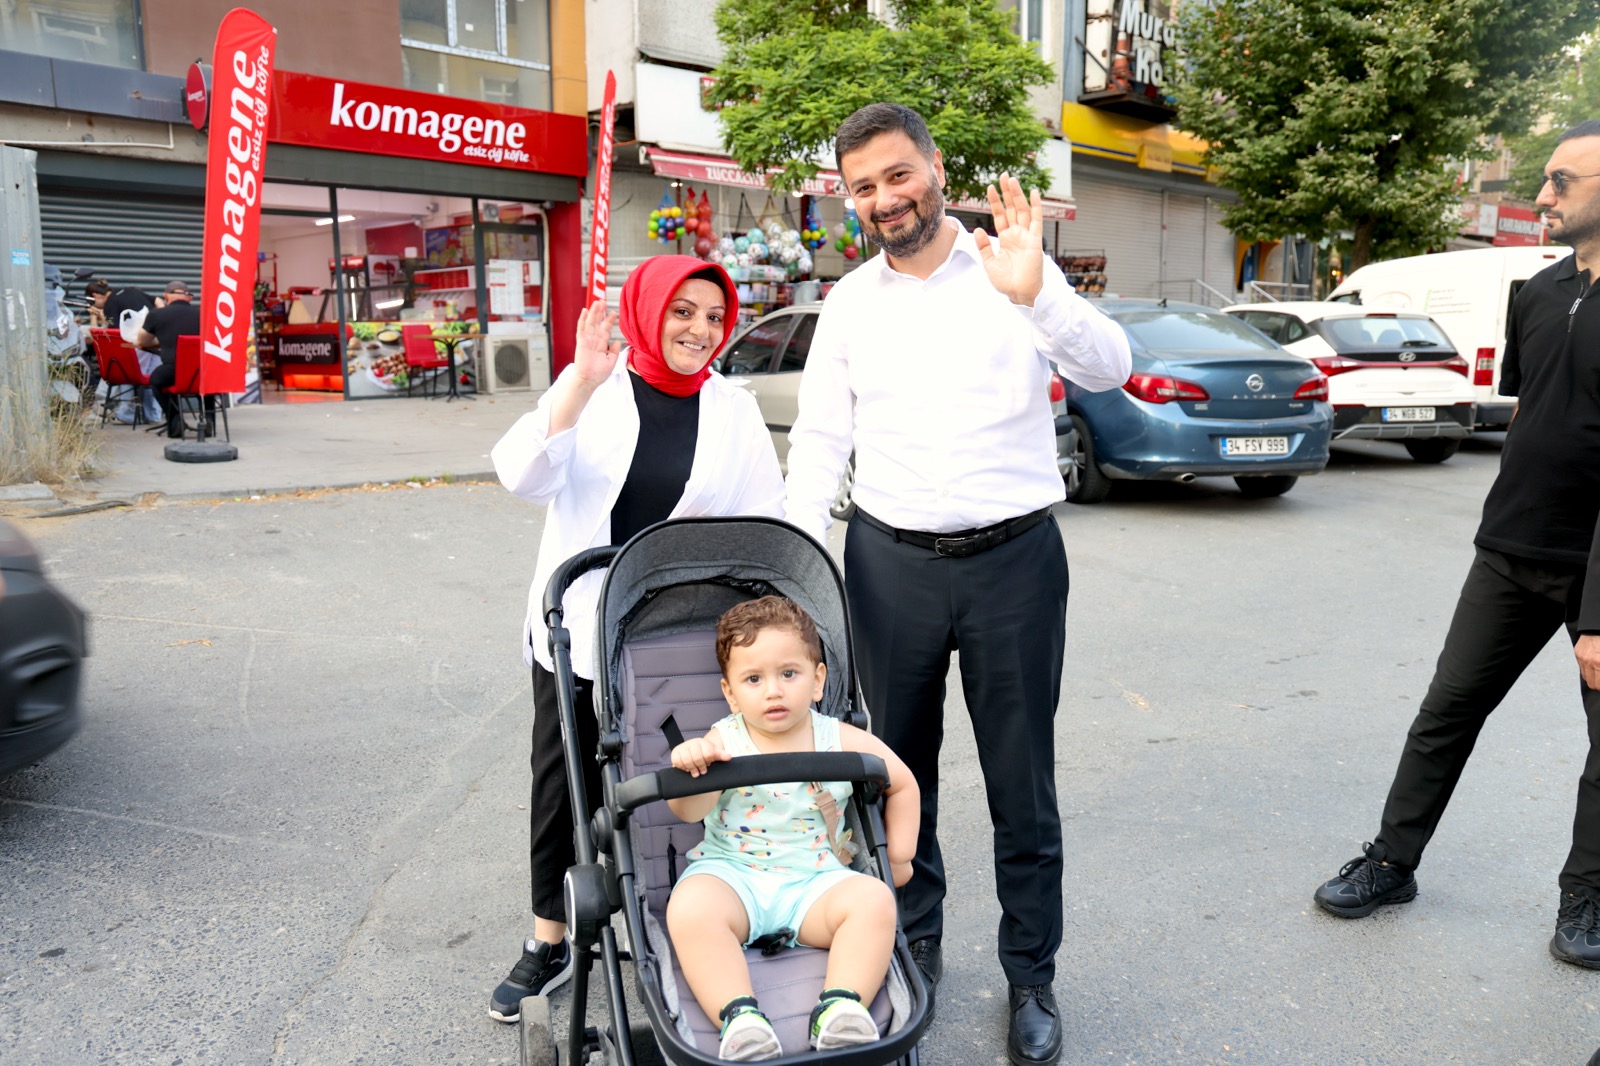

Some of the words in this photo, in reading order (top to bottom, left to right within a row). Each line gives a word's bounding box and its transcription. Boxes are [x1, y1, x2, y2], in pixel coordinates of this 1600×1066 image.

[256, 45, 270, 96] köfte
[330, 83, 526, 153] komagene
[252, 130, 263, 171] etsiz
[463, 145, 487, 158] etsiz
[204, 50, 257, 363] komagene
[279, 337, 331, 362] komagene
[1228, 440, 1240, 452] 34
[1245, 439, 1263, 452] FSV
[1267, 438, 1285, 451] 999
